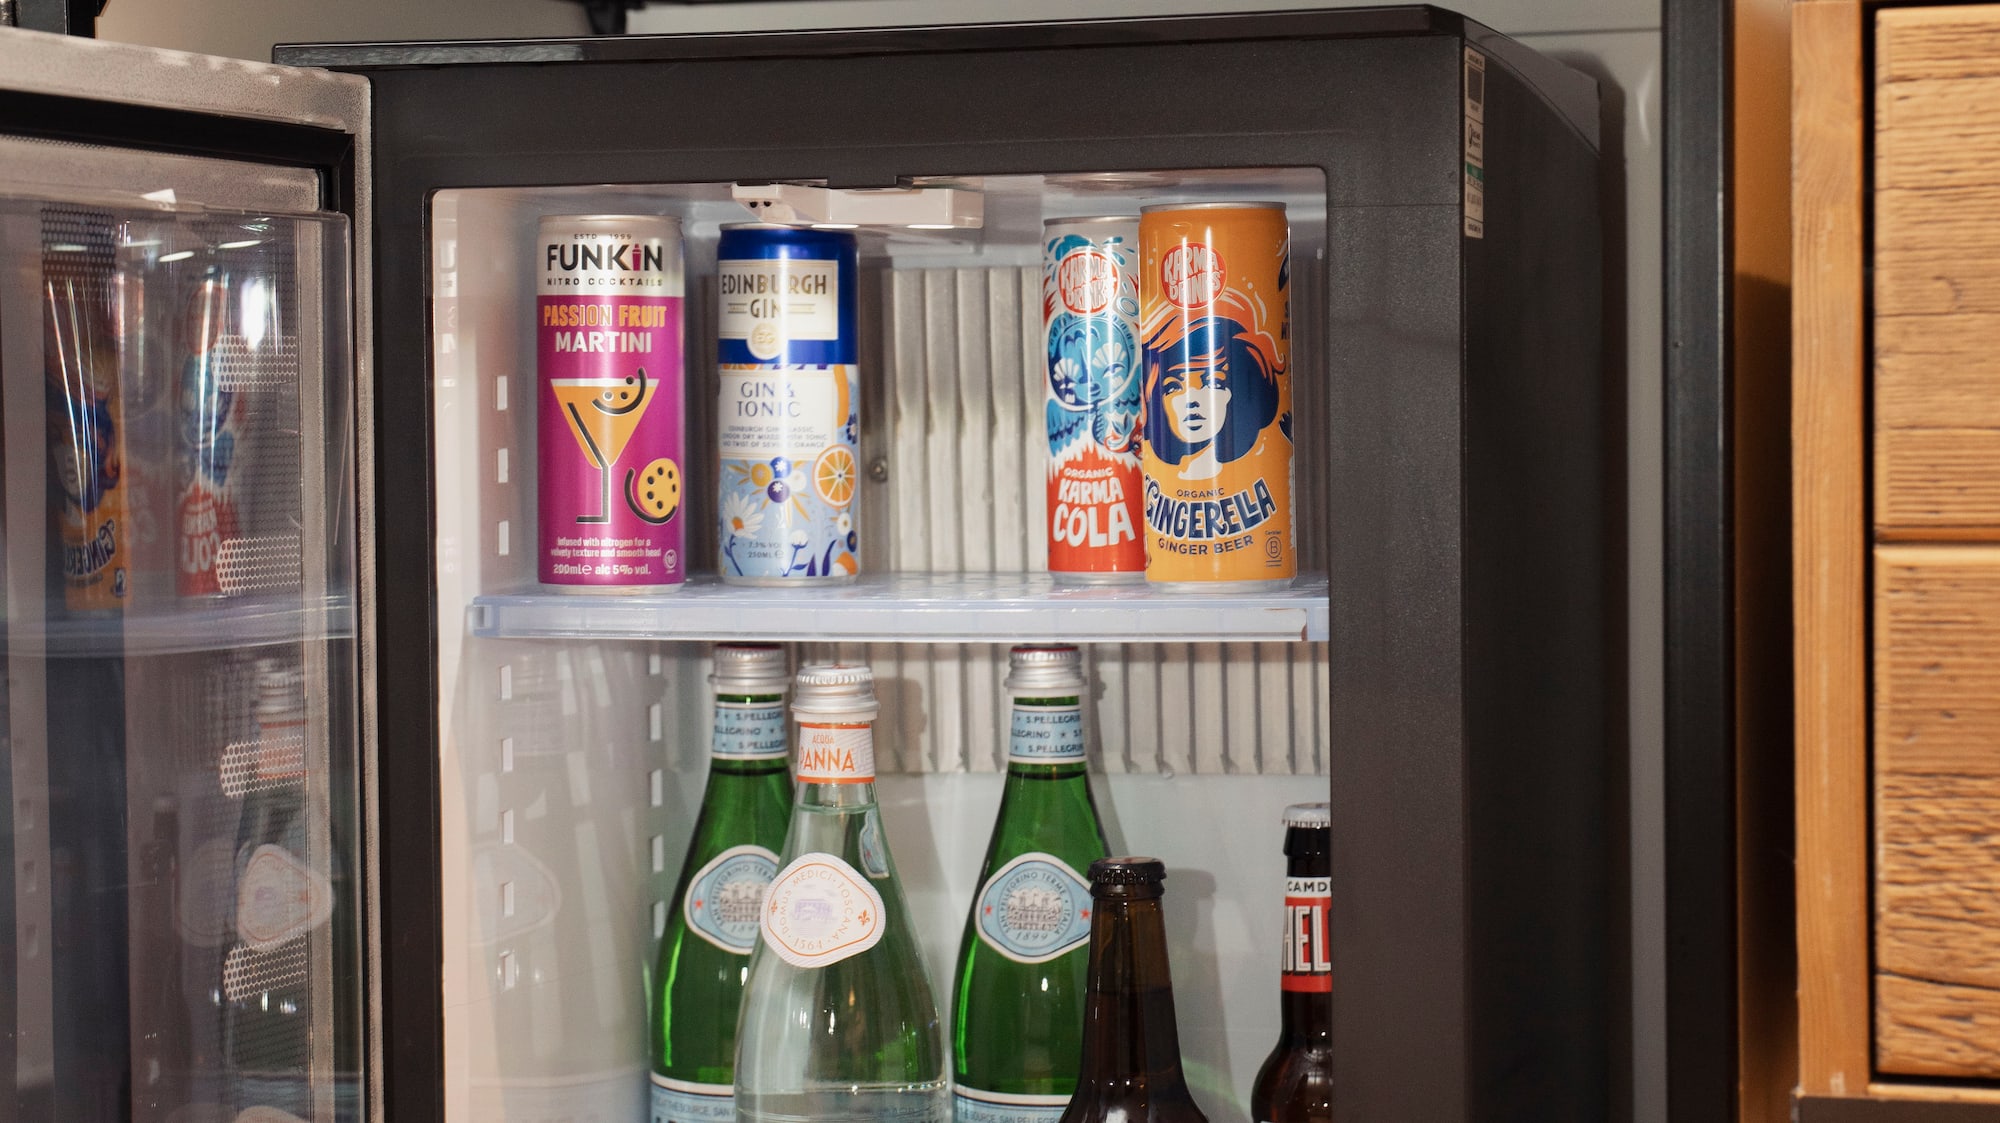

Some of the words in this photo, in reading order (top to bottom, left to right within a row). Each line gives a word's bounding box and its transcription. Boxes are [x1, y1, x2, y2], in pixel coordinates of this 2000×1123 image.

[1164, 248, 1220, 283] KARMA
[547, 278, 580, 286] NITRO
[588, 278, 663, 286] COCKTAILS
[722, 274, 827, 294] EDINBURGH
[1170, 270, 1222, 304] DRINKS
[544, 304, 612, 327] PASSION
[618, 304, 667, 328] FRUIT
[750, 298, 781, 318] GIN
[555, 331, 652, 353] MARTINI
[740, 381, 775, 398] GIN
[736, 401, 801, 417] TONIC
[1064, 467, 1114, 477] ORGANIC
[1058, 477, 1124, 504] KARMA
[1176, 487, 1225, 498] ORGANIC
[1146, 474, 1277, 540] GINGERELLA
[1053, 502, 1136, 548] COLA
[583, 537, 600, 546] with
[1158, 538, 1208, 555] GINGER
[1214, 537, 1254, 555] BEER
[595, 563, 611, 575] alc
[613, 563, 633, 575] 5%
[635, 563, 652, 575] vol.
[1026, 714, 1081, 723] S.PELLEGRI
[812, 734, 835, 745] ACQUA
[999, 871, 1038, 912] PELLEGRINO
[1041, 871, 1067, 895] TERME
[1288, 881, 1332, 892] CAMD
[780, 888, 792, 935] DOMUS
[792, 869, 833, 887] MEDICI
[832, 881, 853, 940] TOSCANA
[1000, 915, 1011, 933] SAN
[1056, 908, 1071, 935] ITALIA
[1283, 905, 1331, 972] HEL
